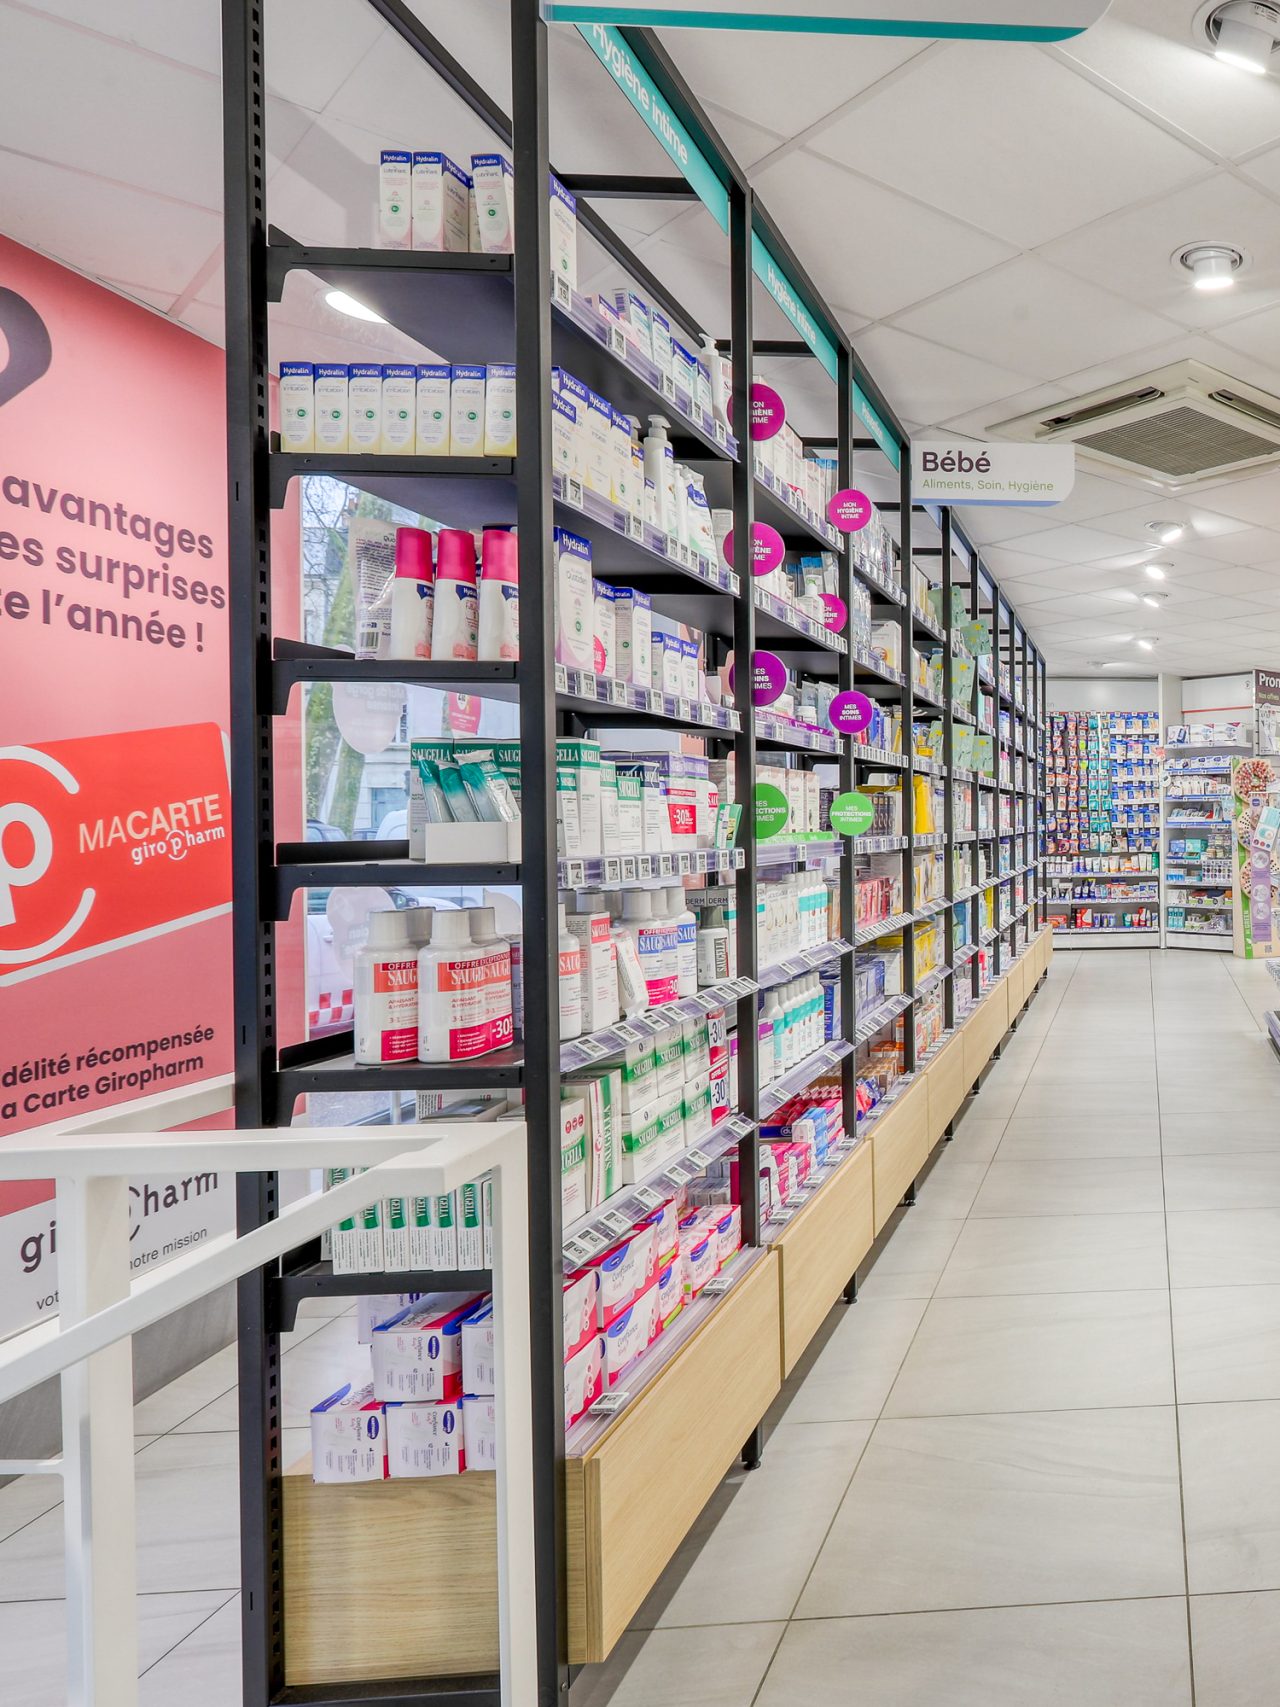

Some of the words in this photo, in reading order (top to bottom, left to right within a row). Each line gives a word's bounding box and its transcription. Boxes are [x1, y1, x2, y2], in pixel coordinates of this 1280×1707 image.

[652, 95, 688, 165] intime
[283, 365, 310, 377] Hydralin
[318, 367, 346, 379] Hydralin
[352, 367, 380, 378] Hydralin
[386, 367, 414, 378] Hydralin
[420, 368, 448, 379] Hydralin
[455, 368, 483, 379] Hydralin
[563, 373, 587, 399] Hydralin
[552, 393, 575, 418] Hydralin
[922, 450, 991, 473] Bébé
[922, 478, 974, 491] Aliments,
[977, 480, 1005, 491] Soin,
[1008, 480, 1054, 493] Hygiène
[2, 475, 214, 559] avantages
[563, 534, 589, 557] Hydralin
[56, 546, 226, 610] surprises
[0, 587, 30, 621] e
[411, 748, 450, 762] SAUGELLA
[79, 793, 224, 854] MACARTE
[131, 825, 226, 866] giropharm
[76, 1024, 215, 1070] récompensée
[23, 1081, 90, 1114] Carte
[95, 1053, 205, 1096] Giropharm
[162, 1226, 209, 1256] mission
